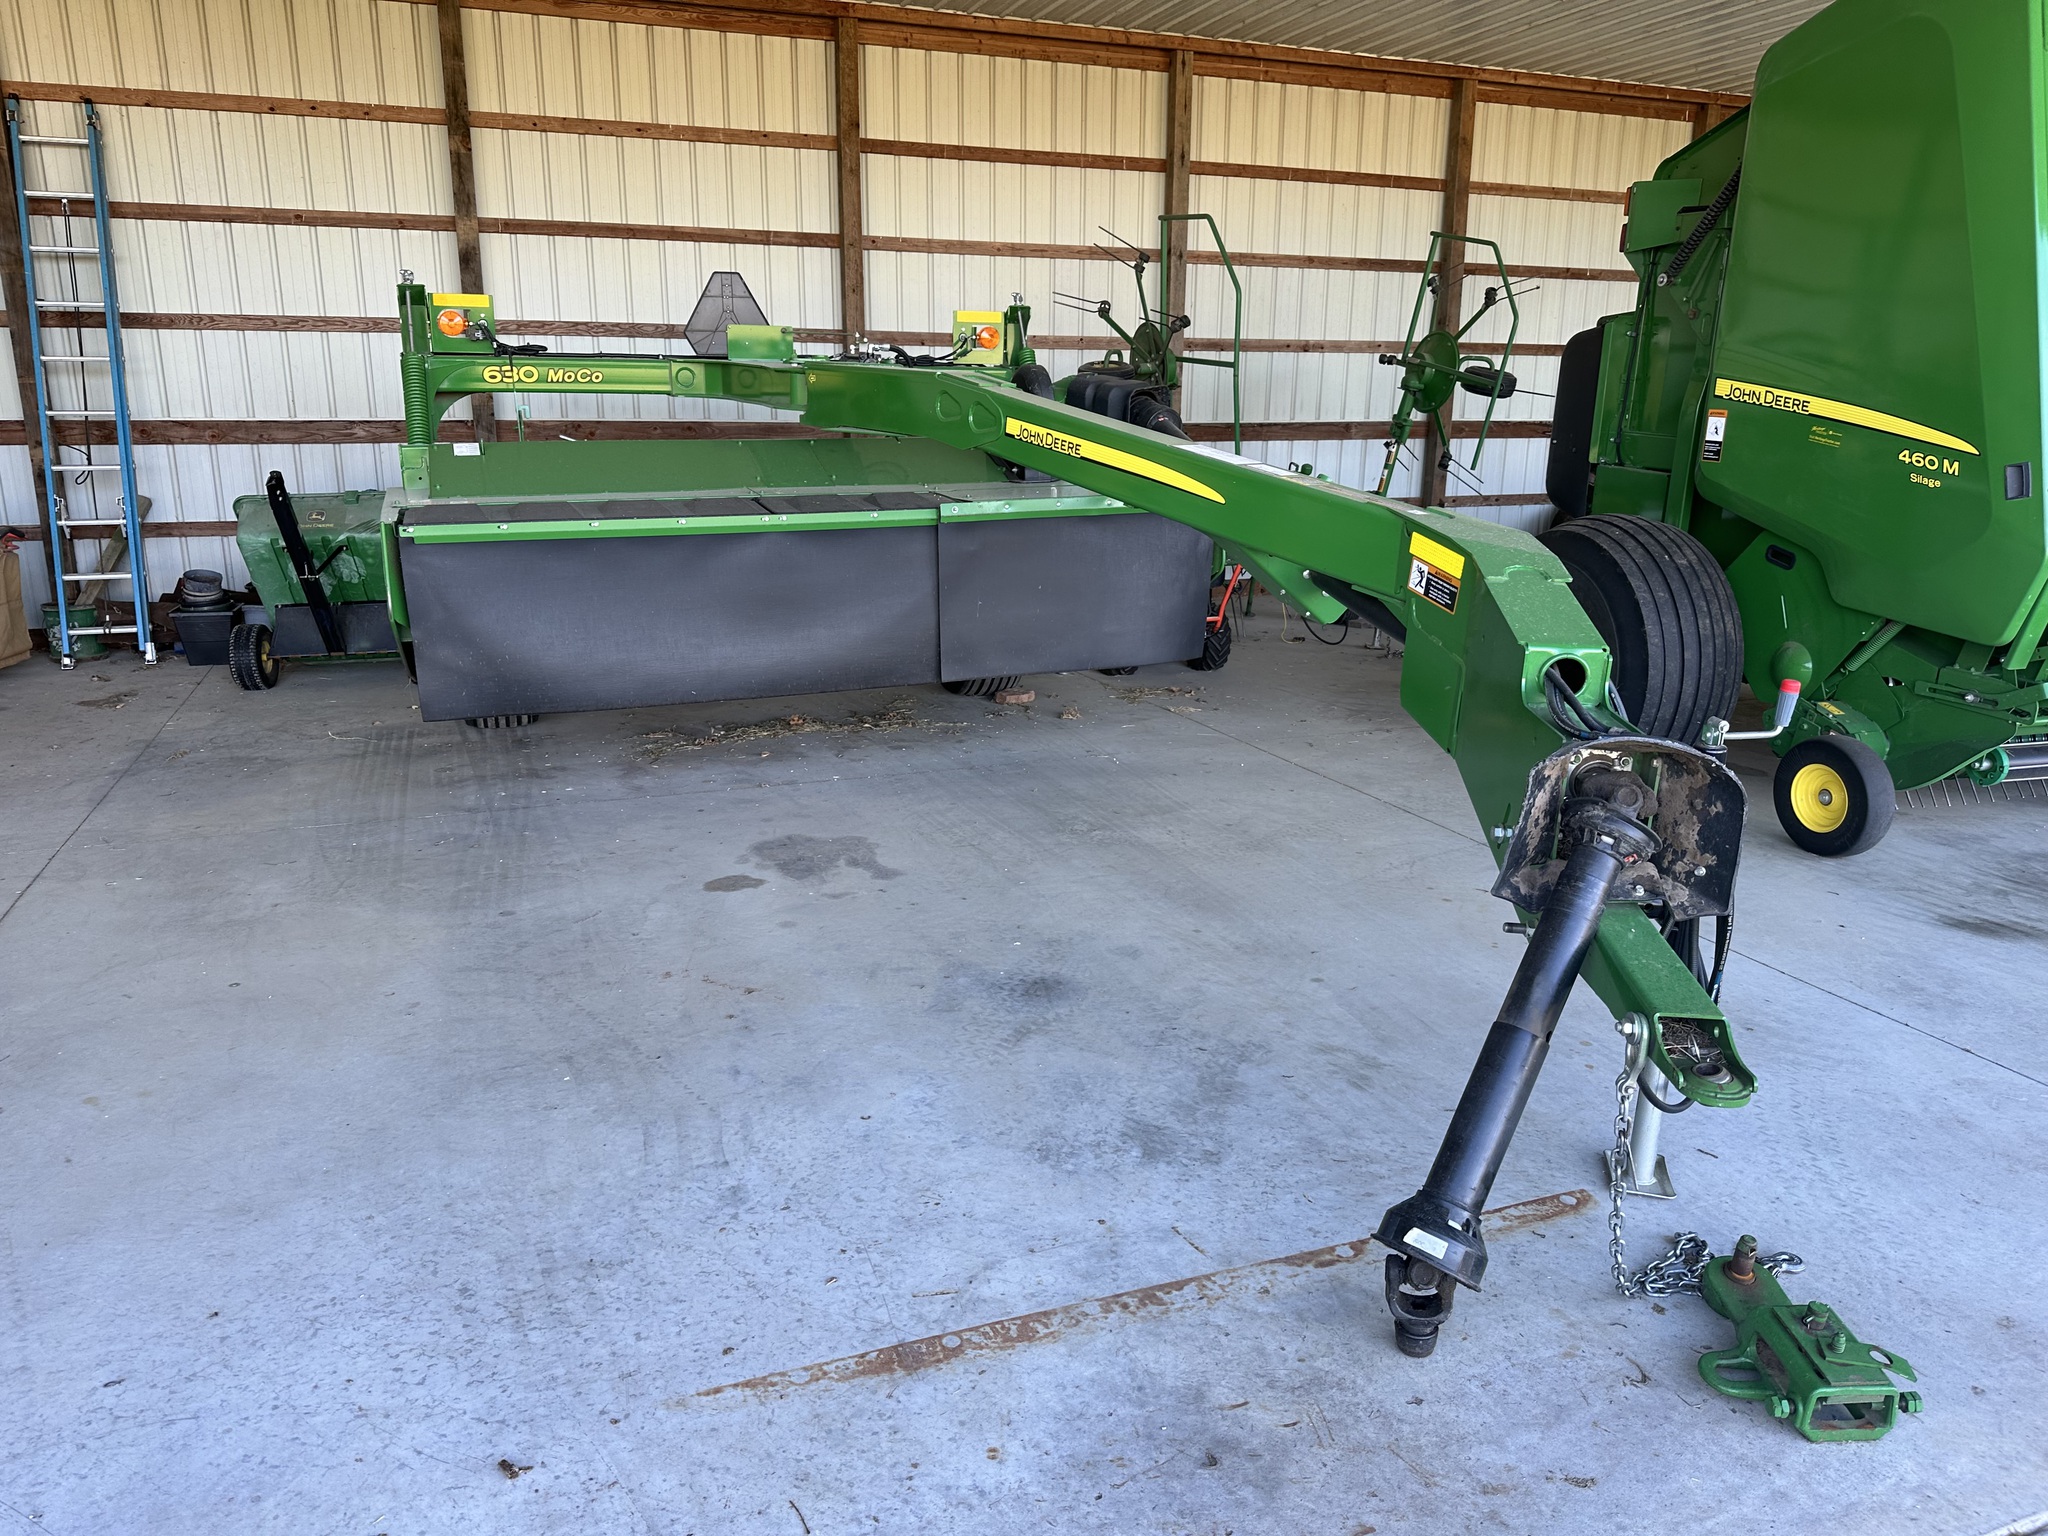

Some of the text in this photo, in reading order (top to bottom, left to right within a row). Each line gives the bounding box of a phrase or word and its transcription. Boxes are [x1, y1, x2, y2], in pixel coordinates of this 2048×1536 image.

[482, 365, 604, 384] 630 MoCo
[1724, 384, 1811, 413] JOHN DEERE
[1016, 424, 1082, 456] JOHN DEERE
[1898, 448, 1960, 476] 460 M
[1909, 473, 1941, 488] Silage
